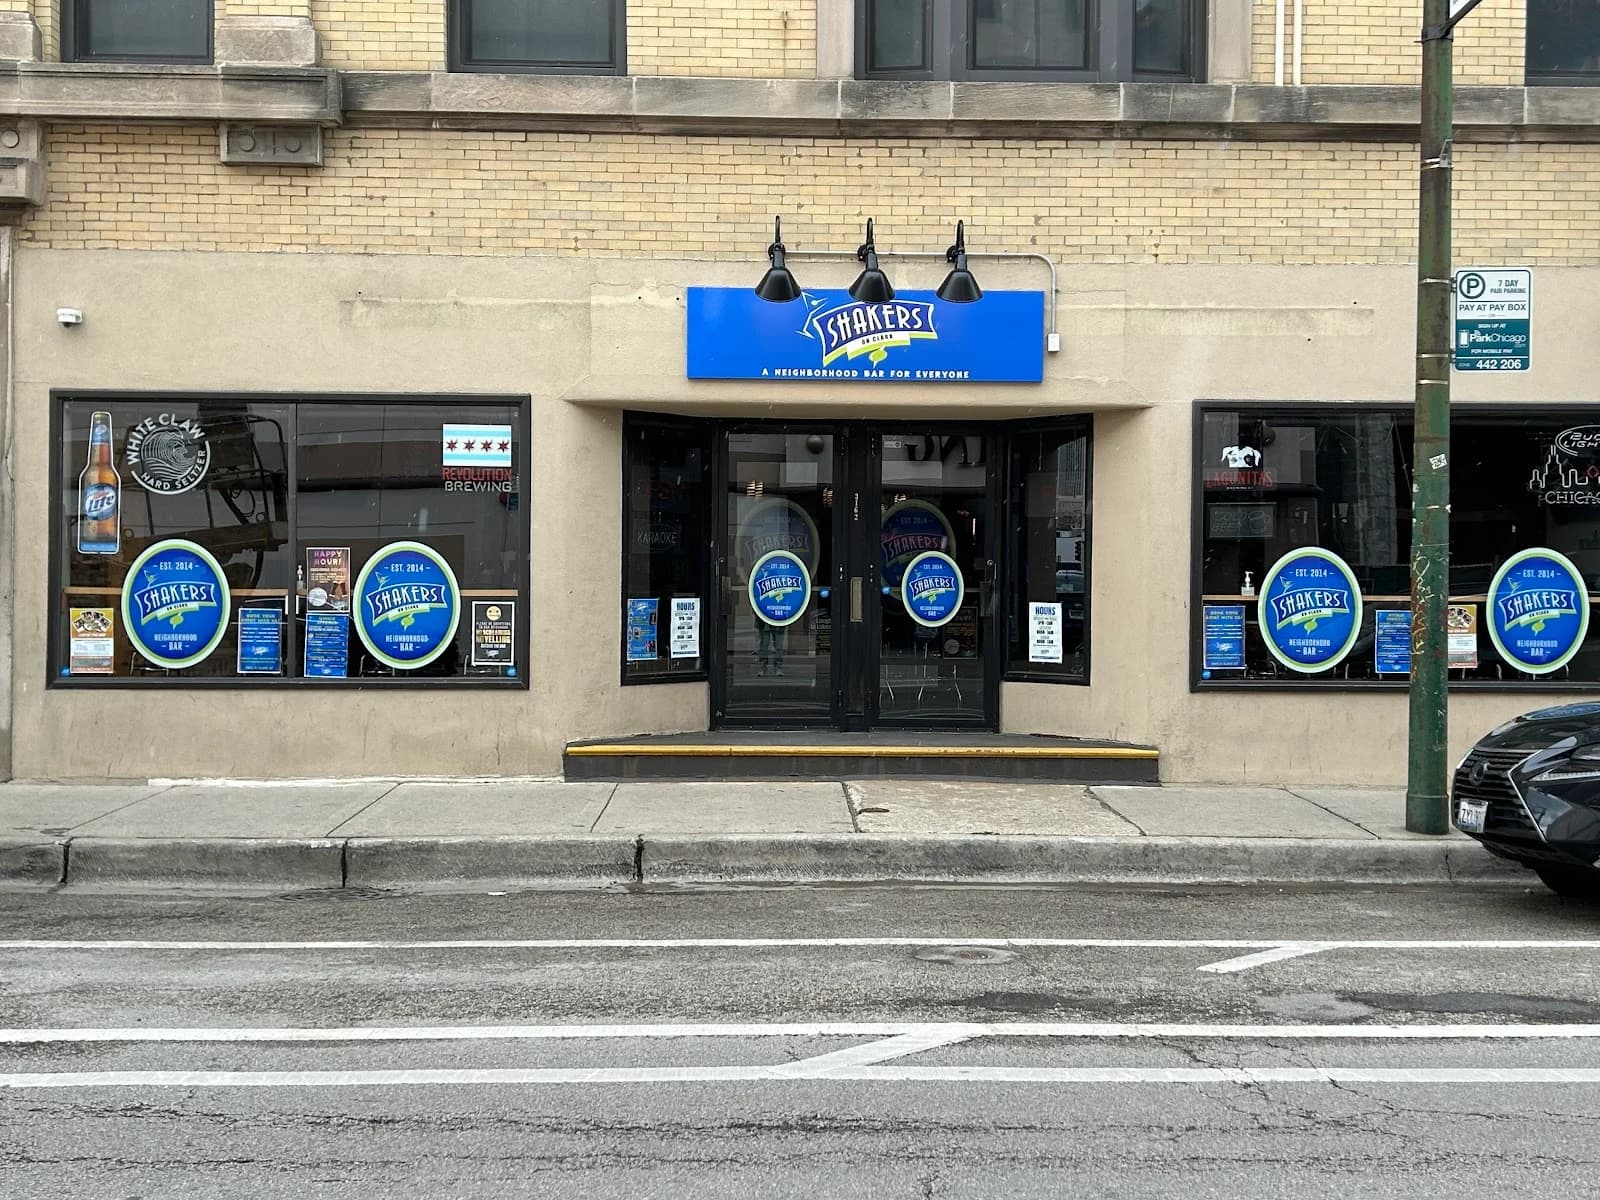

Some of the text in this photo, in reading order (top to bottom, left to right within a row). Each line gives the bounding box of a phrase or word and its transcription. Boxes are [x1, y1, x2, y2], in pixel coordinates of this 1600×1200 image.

[827, 304, 923, 348] SHAKERS
[872, 334, 894, 342] CLARK
[1470, 333, 1526, 343] ParkChicago
[1476, 360, 1522, 369] 442 206
[762, 368, 969, 378] A NEIGHBORHOOD BAR FOR EVERYONE
[126, 413, 206, 465] WHITE CLAW
[1564, 440, 1600, 448] LIGH
[141, 450, 206, 490] HARD SELTZER
[442, 467, 512, 480] REVOLUTION
[1206, 471, 1273, 488] LAGUNITAS
[444, 480, 512, 492] BREWING
[88, 495, 114, 512] Lite
[638, 532, 678, 544] KARAOKE
[890, 536, 938, 558] SHAKERS
[160, 562, 193, 570] EST. 2014
[391, 564, 424, 572] EST. 2014
[1311, 569, 1328, 577] 2014
[1523, 570, 1555, 578] EST. 2014
[761, 578, 796, 593] SHAKERS
[914, 578, 950, 593] SHAKERS
[144, 584, 207, 613] SHAKERS
[375, 586, 437, 614] SHAKERS
[676, 602, 695, 611] HOURS
[1280, 591, 1340, 618] SHAKERS
[1507, 592, 1567, 619] SHAKERS
[1035, 607, 1056, 615] HOURS
[168, 642, 182, 650] BAR
[400, 643, 414, 651] BAR
[1303, 647, 1316, 656] BAR
[1530, 648, 1544, 656] BAR
